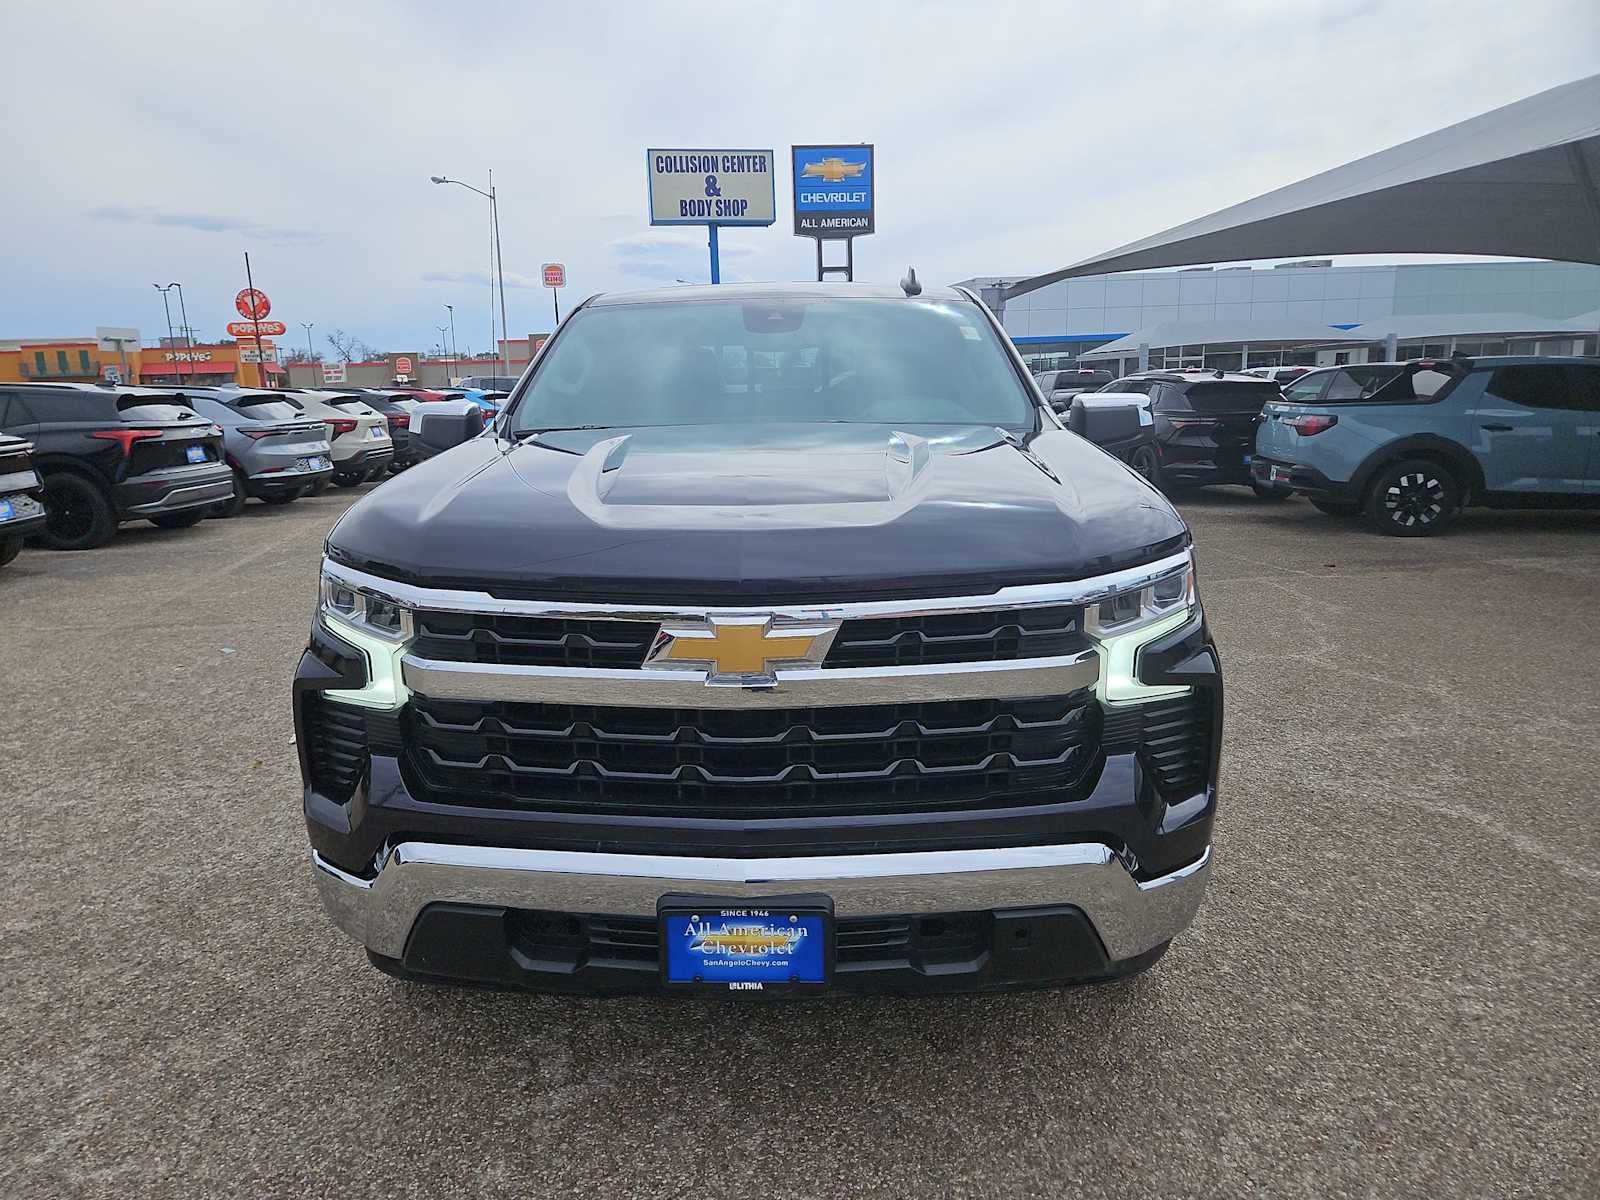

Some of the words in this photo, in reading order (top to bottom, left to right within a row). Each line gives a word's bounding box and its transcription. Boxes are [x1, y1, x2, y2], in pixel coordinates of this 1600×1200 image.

[655, 155, 719, 173] COLLISION
[721, 155, 767, 173] CENTER
[704, 175, 721, 197] &
[800, 192, 867, 203] CHEVROLET
[679, 199, 712, 217] BODY
[715, 199, 748, 217] SHOP
[800, 218, 818, 228] ALL
[820, 217, 869, 228] AMERICAN
[683, 922, 711, 937] All
[719, 922, 809, 937] American
[700, 939, 794, 955] Chevrolet
[703, 959, 789, 967] SanAngeloChevy.com
